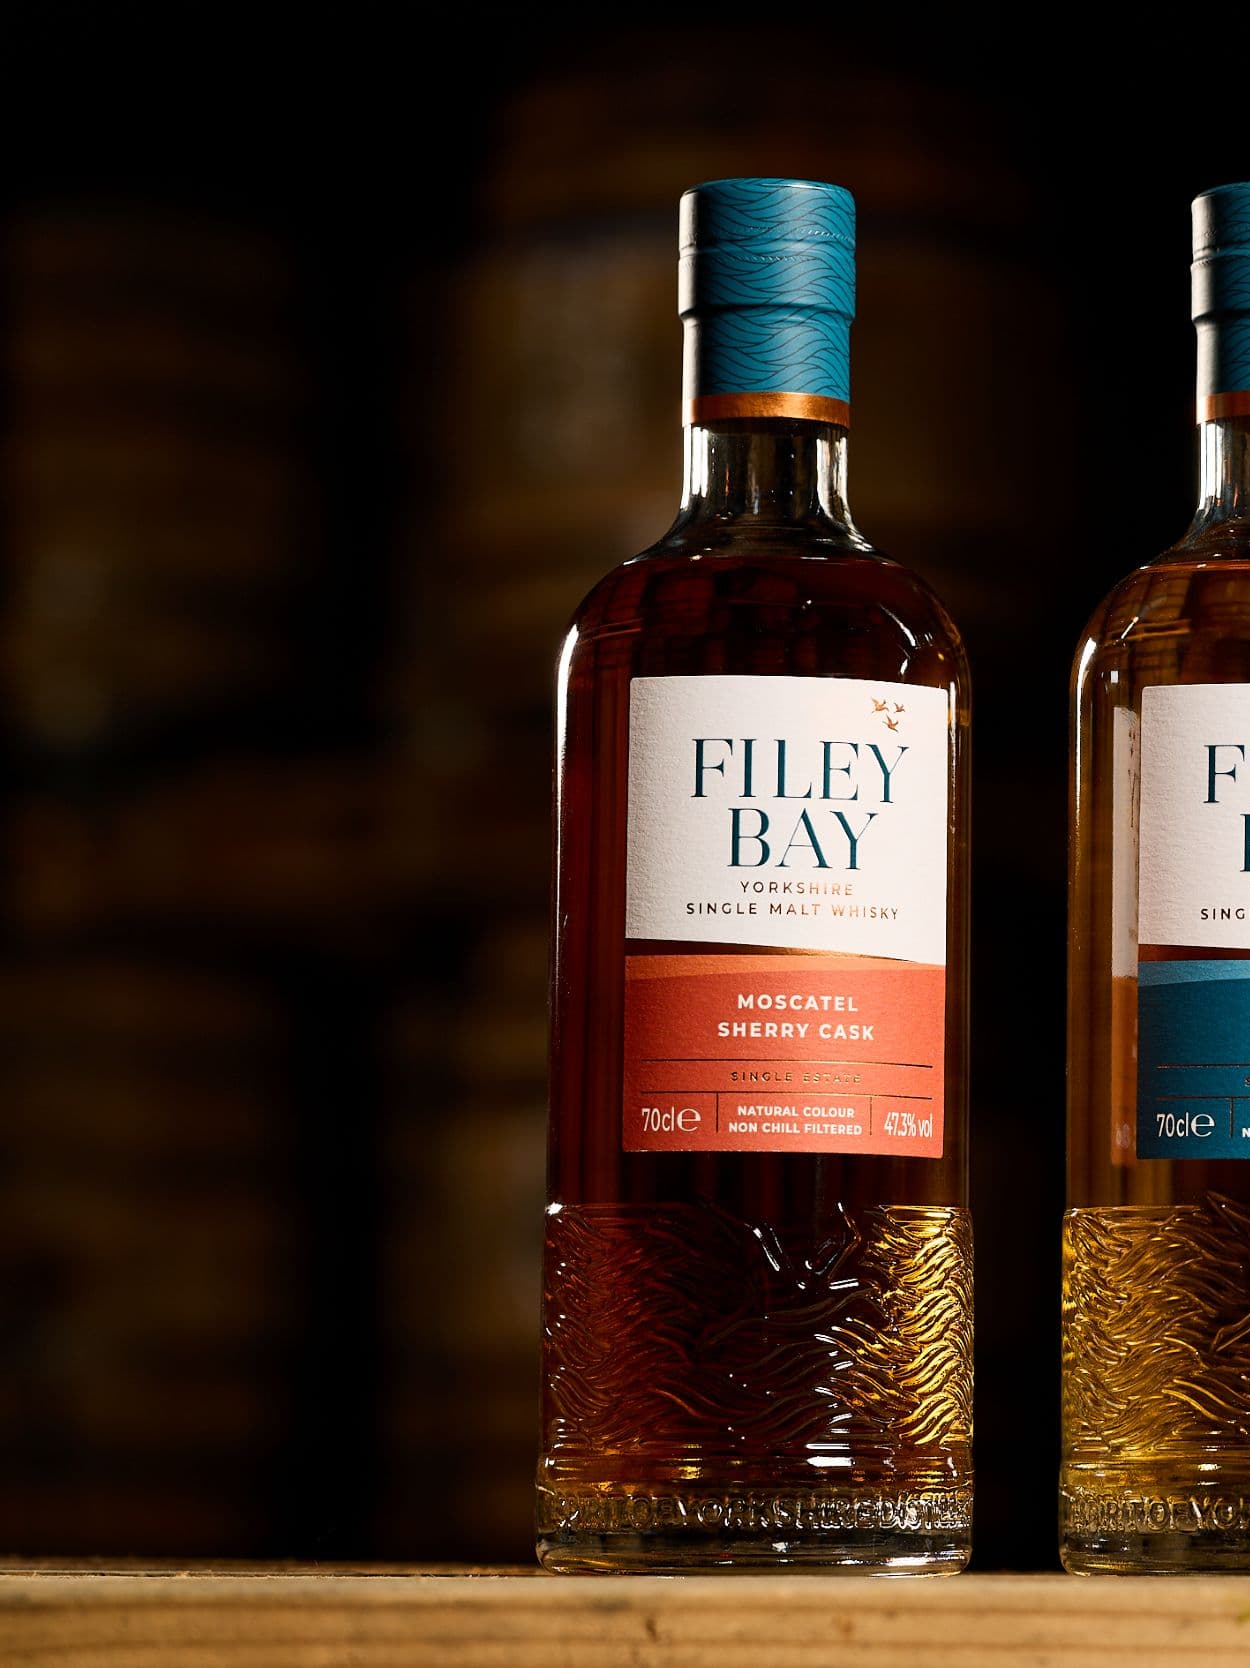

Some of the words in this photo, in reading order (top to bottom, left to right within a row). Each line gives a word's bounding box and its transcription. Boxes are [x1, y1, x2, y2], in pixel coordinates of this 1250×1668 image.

[691, 738, 909, 803] FILEY
[727, 807, 878, 870] BAY
[740, 880, 854, 897] YORKSHIRE
[686, 902, 758, 916] SINGLE
[769, 902, 822, 917] MALT
[831, 903, 900, 921] WHISKY
[737, 993, 859, 1012] MOSCATEL
[717, 1021, 807, 1039] SHERRY
[819, 1023, 875, 1041] CASK
[730, 1070, 793, 1083] SINGLE
[802, 1071, 862, 1085] ESTATE
[737, 1104, 799, 1117] NATURAL
[803, 1105, 855, 1118] COLOUR
[728, 1121, 757, 1134] NON
[761, 1121, 800, 1135] CHILL
[804, 1122, 863, 1136] FILTERED
[883, 1113, 916, 1137] 47.3%
[917, 1115, 933, 1138] vol
